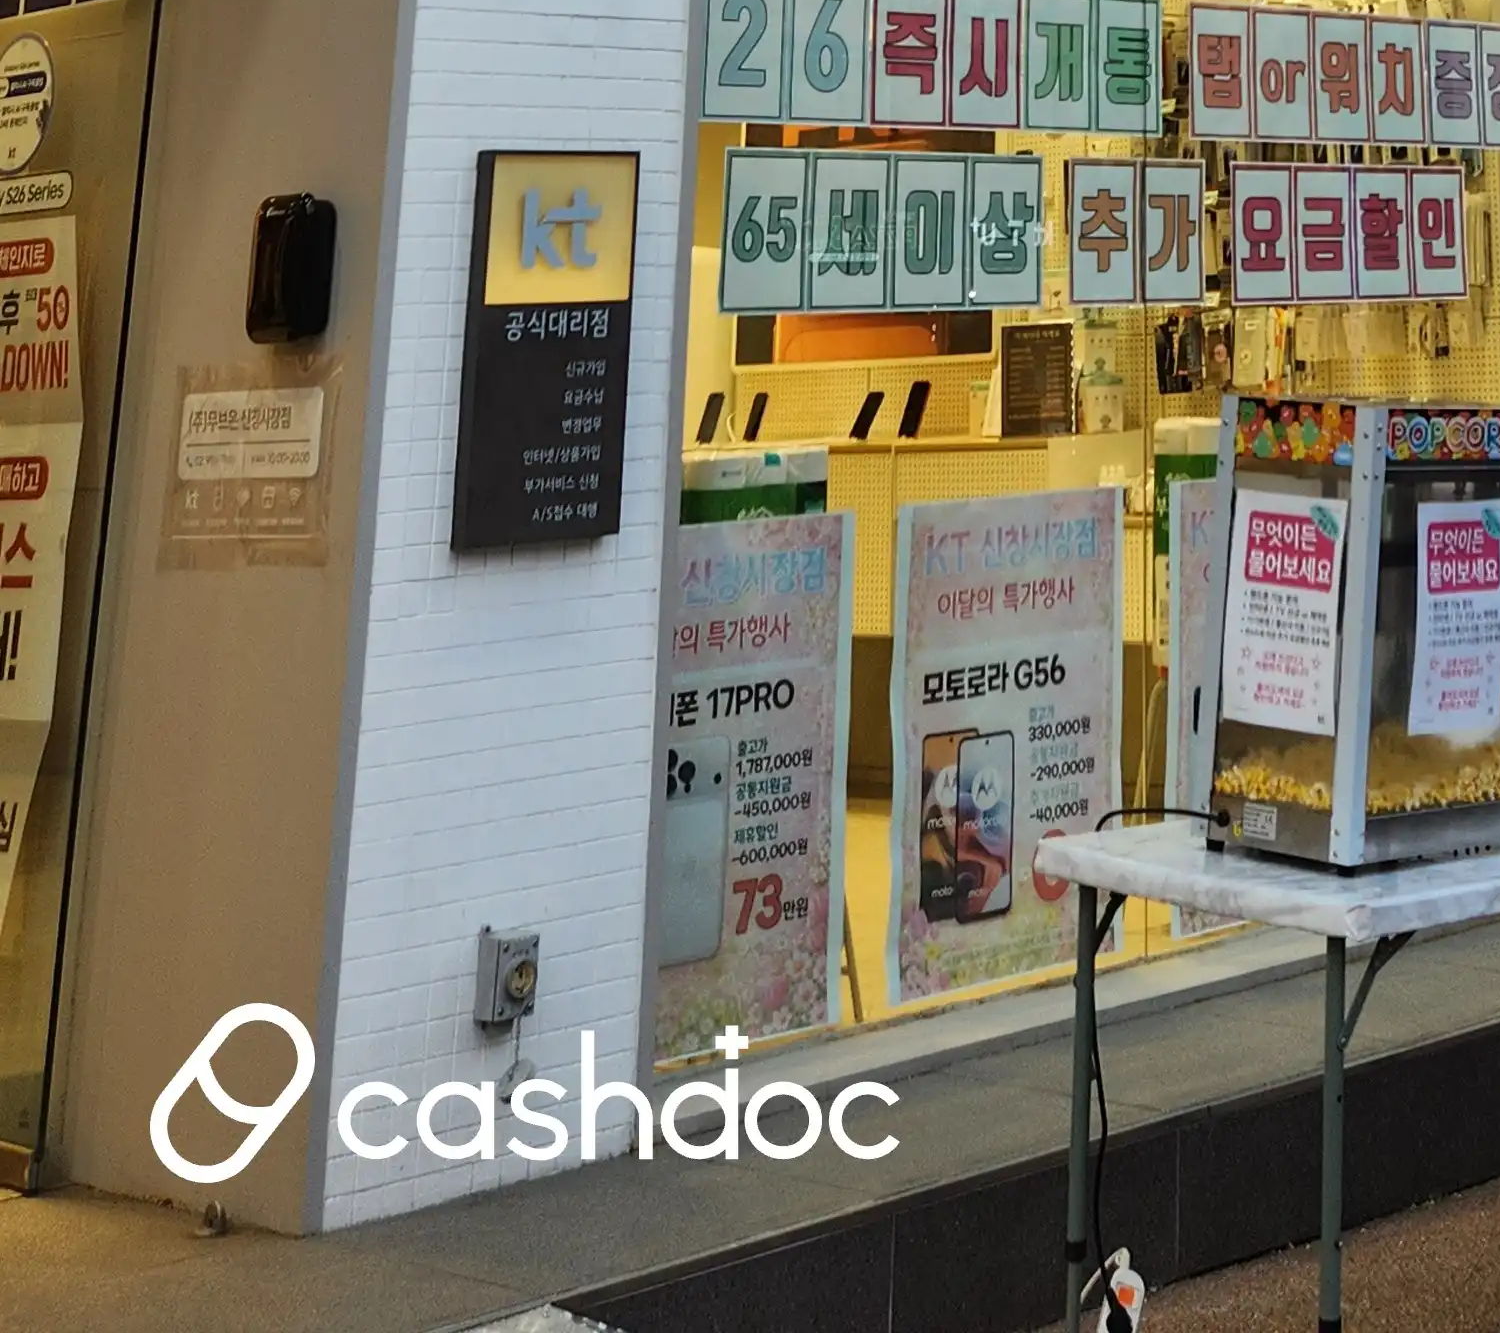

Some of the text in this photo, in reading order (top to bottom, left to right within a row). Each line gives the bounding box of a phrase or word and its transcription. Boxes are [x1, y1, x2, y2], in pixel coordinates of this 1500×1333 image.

[882, 10, 1009, 99] 즉시
[1033, 21, 1152, 105] 개통
[5, 179, 65, 206] S26 Series
[519, 186, 603, 270] kt
[1077, 188, 1197, 274] 추가
[1240, 193, 1457, 274] 요금할인
[505, 308, 610, 342] 공식대리점
[1, 339, 70, 392] DOWN!
[564, 359, 607, 379] 신규가입
[563, 387, 604, 406] 요금수납
[561, 415, 602, 434] 변경업무
[522, 444, 601, 466] 인터넷/상품가입
[523, 473, 600, 495] 부가서비스 신청
[532, 502, 599, 524] A/S접수 대행
[925, 516, 1099, 576] KT 신창시장점
[1250, 517, 1318, 552] 무엇이든
[1427, 525, 1485, 557] 무엇이든
[682, 546, 828, 609] 신창시장점
[1248, 548, 1332, 585] 물어보세요
[1428, 557, 1499, 587] 물어보세요
[937, 576, 1075, 621] 이달의 특가행사
[706, 612, 791, 654] 특가행사
[922, 653, 1066, 705] 모토로라 G56
[706, 678, 795, 719] 17PRO
[1028, 715, 1091, 743] 330,000원
[735, 747, 813, 778] 1,787,000원
[737, 737, 769, 758] 출고가
[1030, 756, 1095, 782] -290,000원
[735, 776, 792, 802] 공통지원금
[734, 791, 811, 818] -450,000원
[1029, 798, 1089, 824] -40,000원
[731, 838, 809, 866] -600,000원
